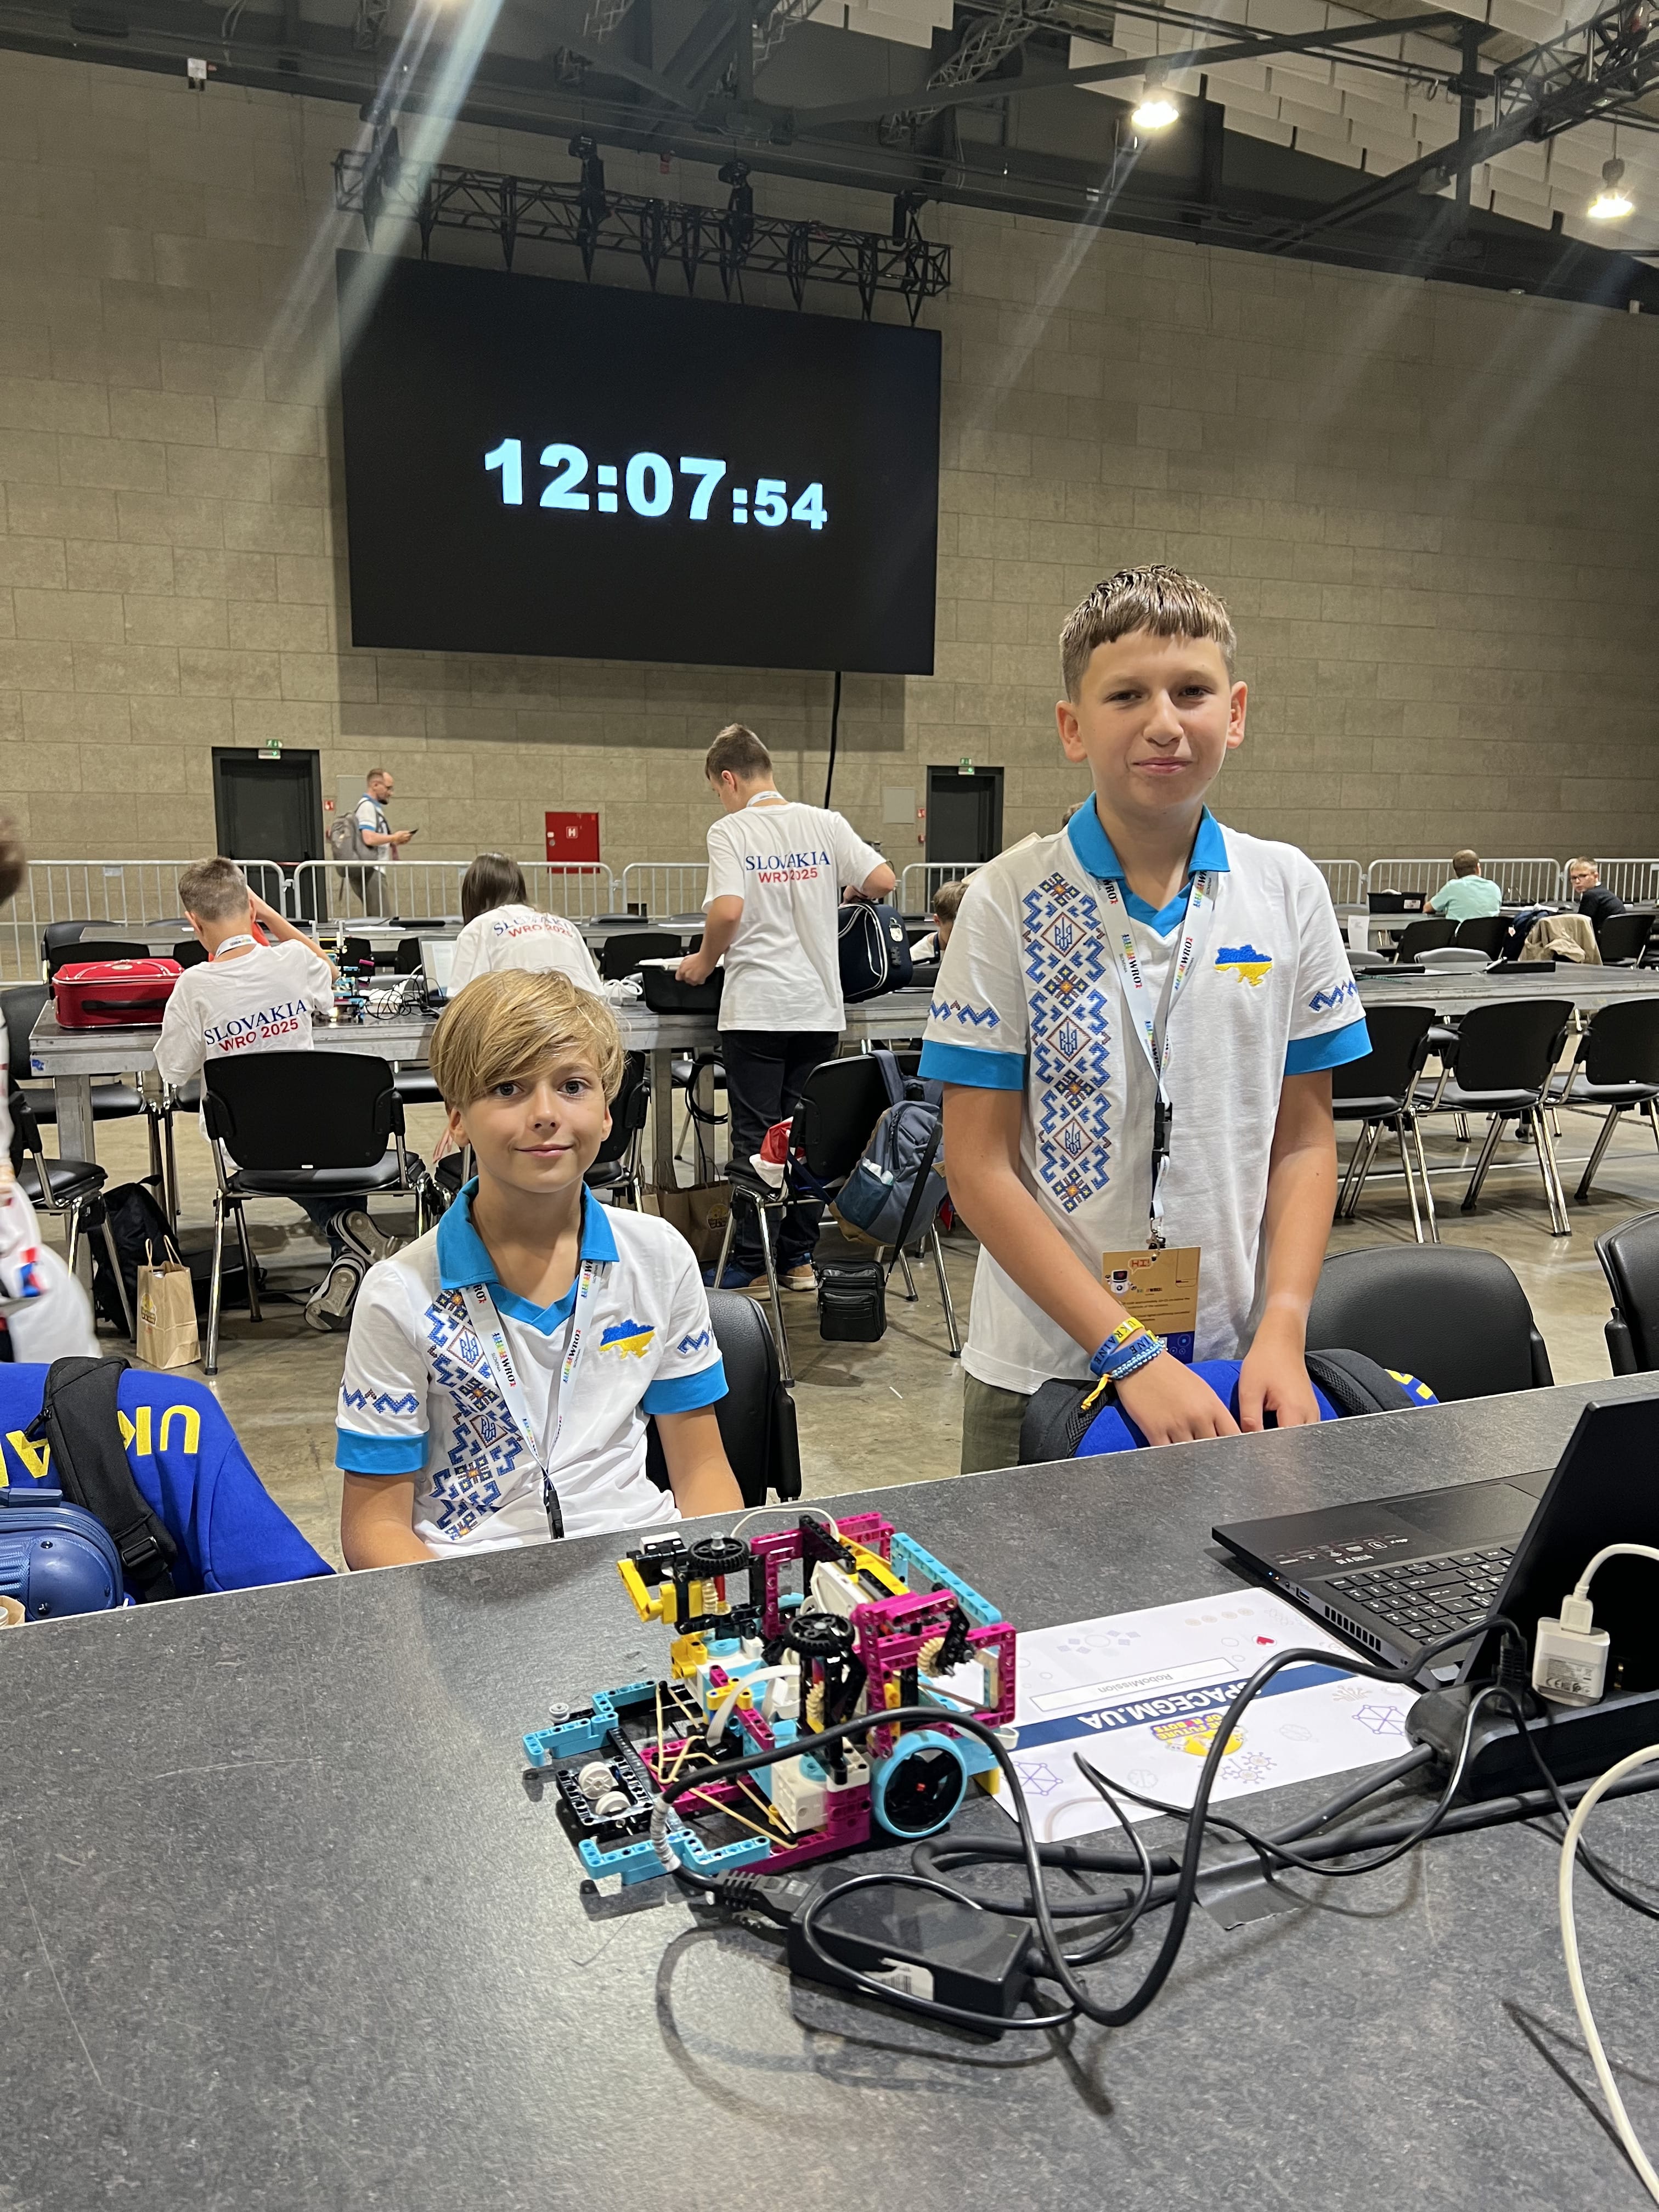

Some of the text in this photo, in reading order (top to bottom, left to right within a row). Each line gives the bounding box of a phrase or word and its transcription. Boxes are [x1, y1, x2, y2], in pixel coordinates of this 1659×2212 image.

[485, 438, 827, 530] 12:07:54
[746, 851, 830, 871] SLOVAKIA
[508, 924, 542, 938] WRO
[1181, 941, 1192, 963] WRO
[1129, 960, 1142, 984] WRO
[205, 999, 307, 1045] SLOVAKIA
[219, 1018, 299, 1052] WRO 2025
[473, 1284, 485, 1299] RO
[569, 1334, 580, 1356] WRO
[502, 1358, 515, 1382] WRO
[0, 1404, 200, 1487] UKA
[1097, 1674, 1173, 1693] RoboMission
[1156, 1724, 1207, 1740] FUTURE
